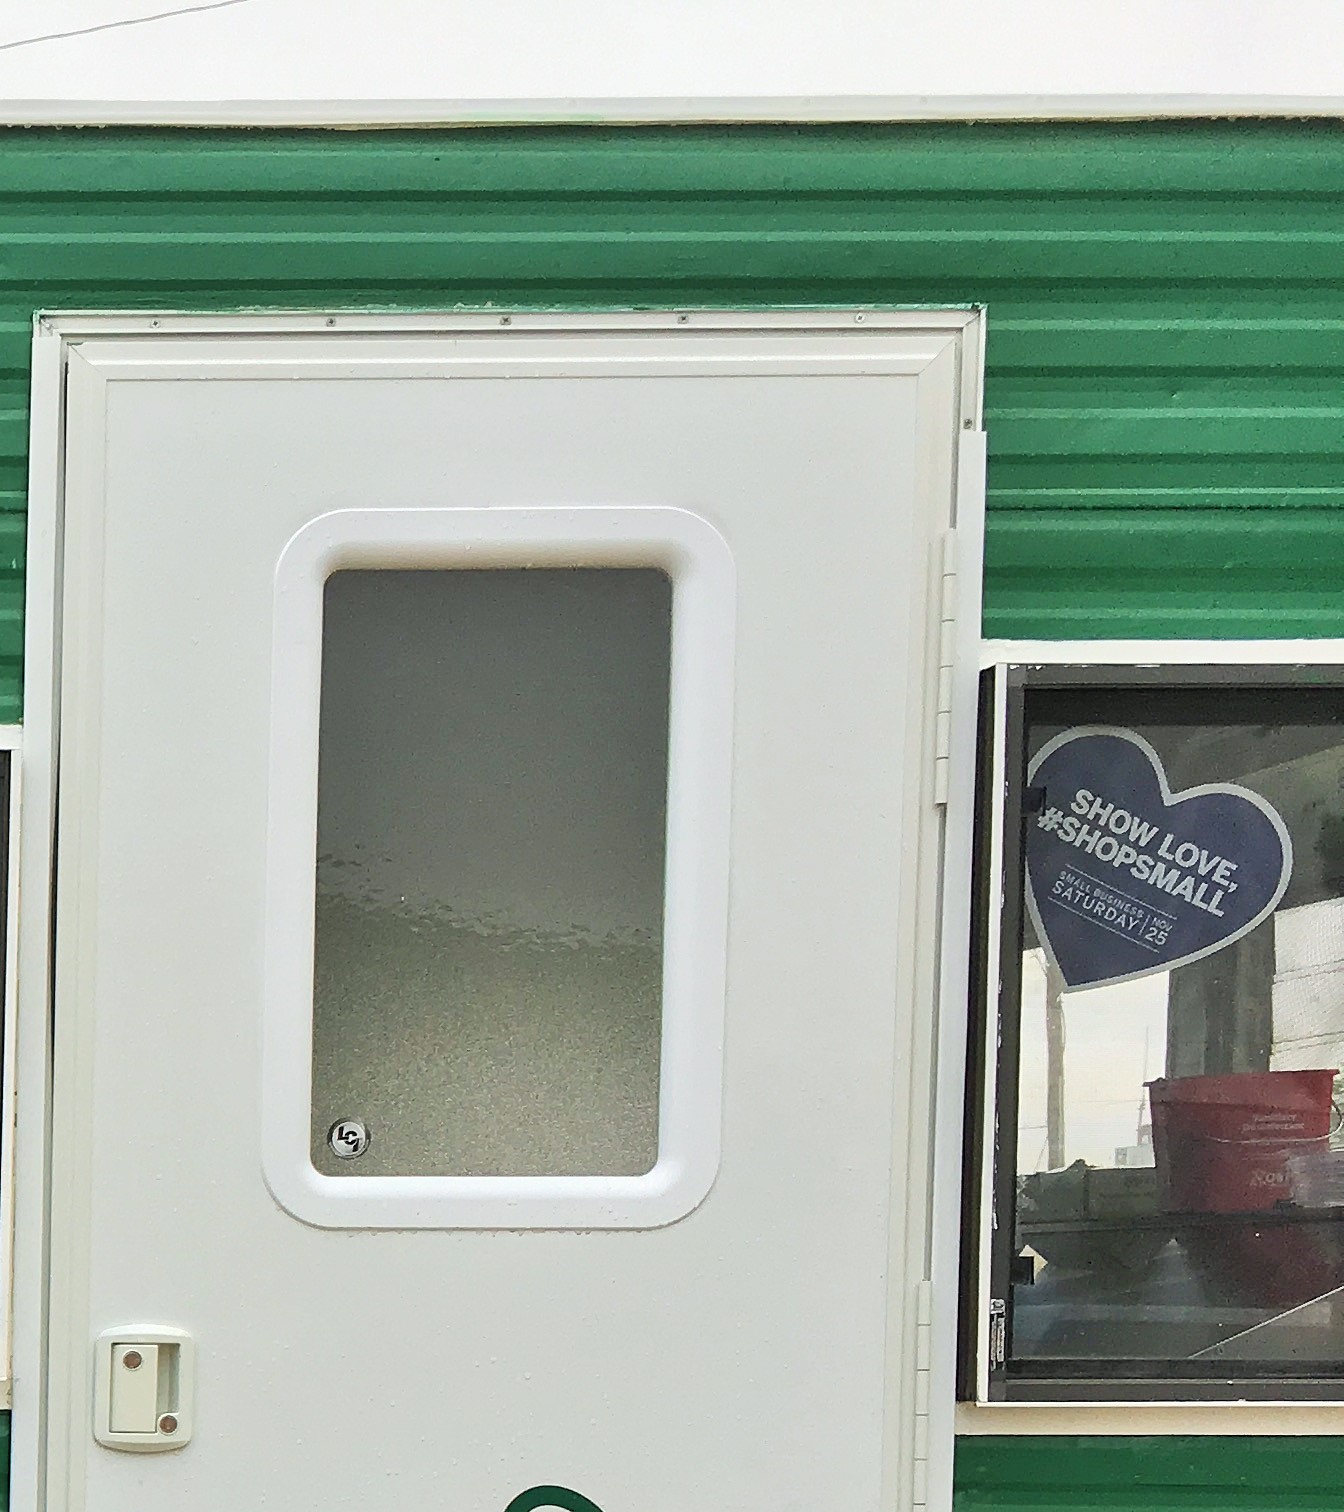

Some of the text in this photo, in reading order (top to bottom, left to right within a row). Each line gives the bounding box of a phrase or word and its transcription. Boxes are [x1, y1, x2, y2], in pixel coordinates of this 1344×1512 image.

[1037, 805, 1225, 917] #SHOPSMALL
[1070, 788, 1239, 892] SHOW LOVE,
[1052, 880, 1140, 930] SATURDAY
[1059, 870, 1144, 918] SMALL BUSINESS
[1144, 927, 1169, 945] 25
[1150, 917, 1172, 932] NOV
